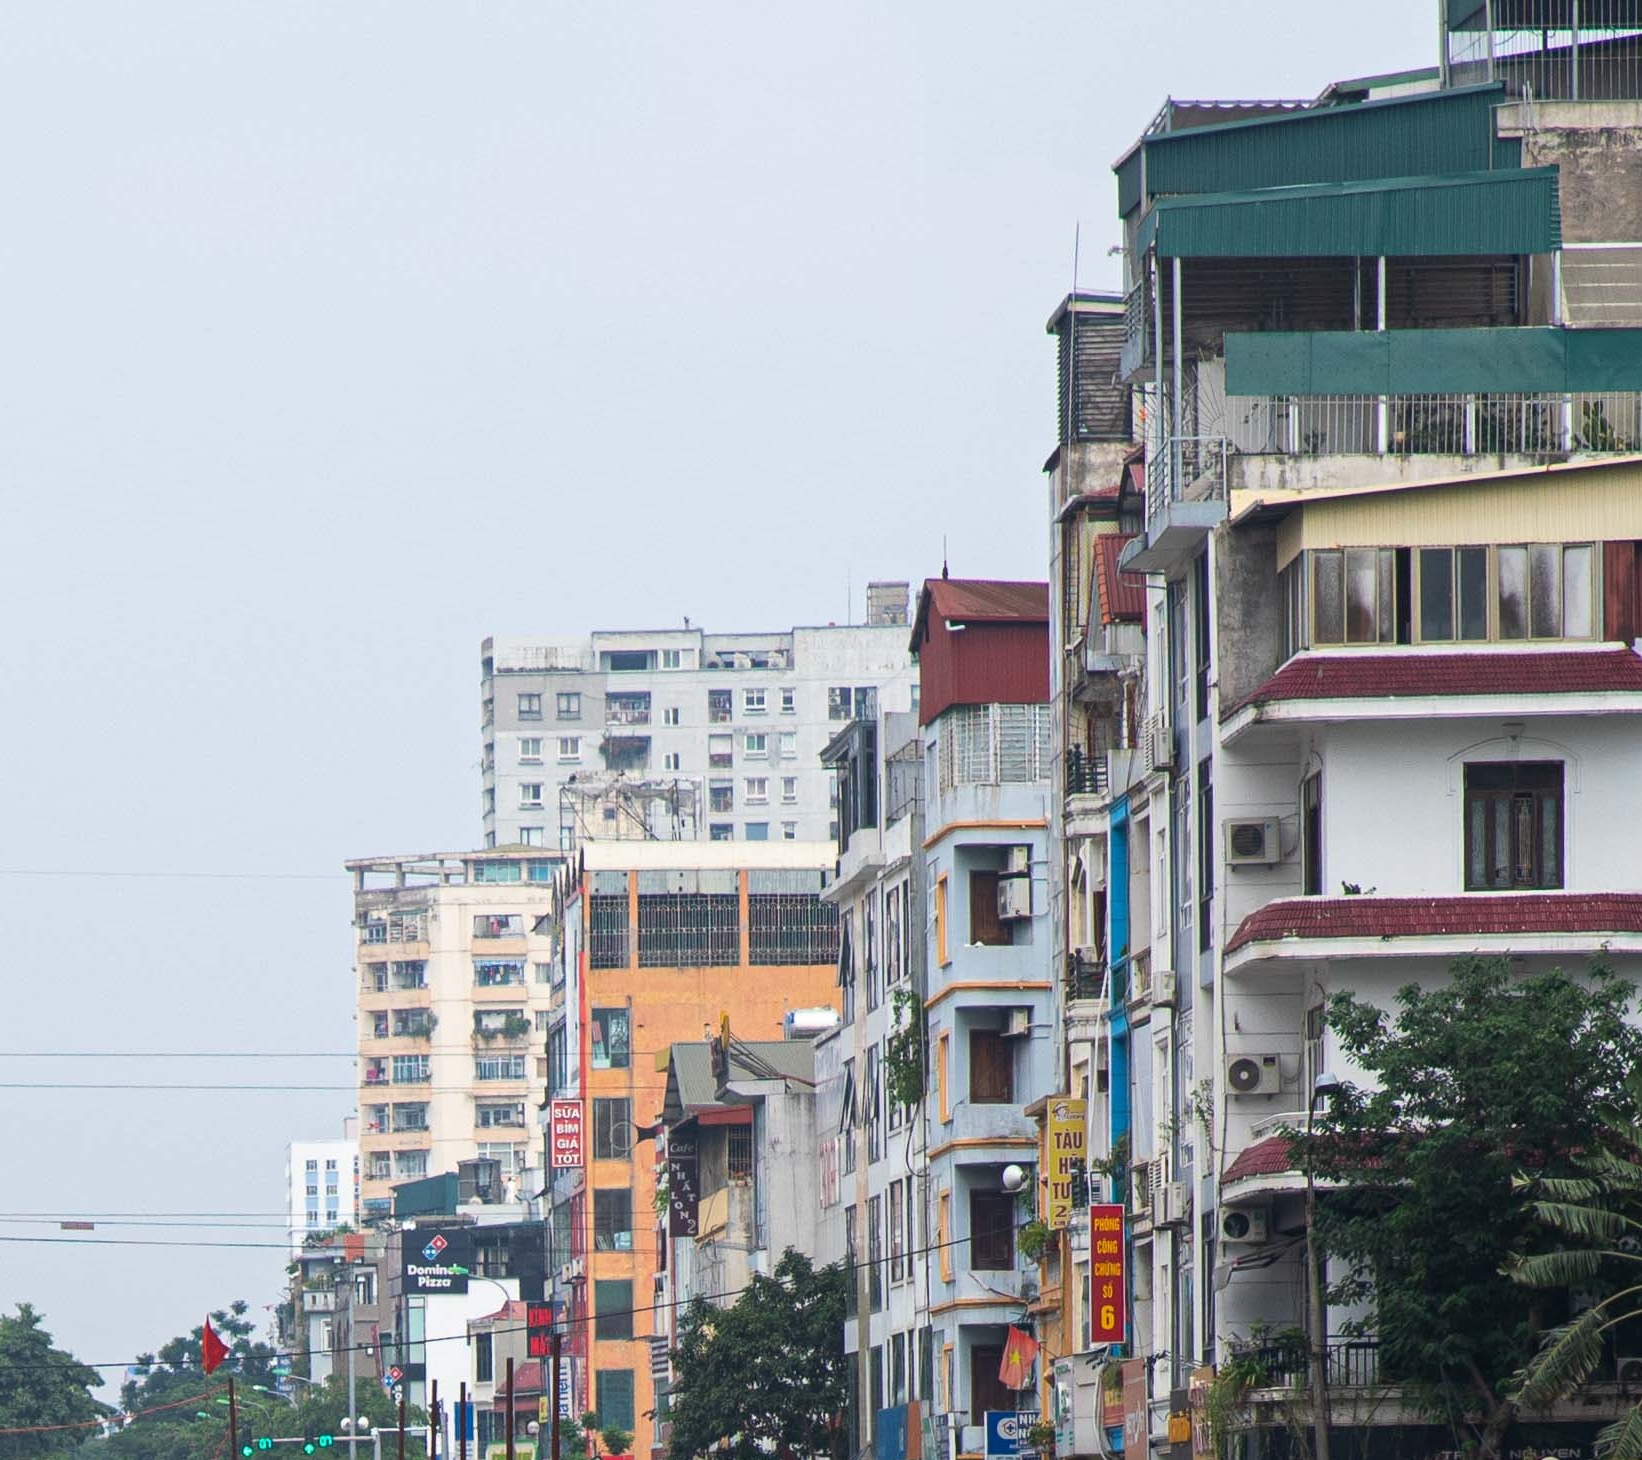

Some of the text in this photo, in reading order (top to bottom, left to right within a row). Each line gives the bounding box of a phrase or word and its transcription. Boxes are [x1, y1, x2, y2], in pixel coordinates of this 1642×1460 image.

[554, 1107, 581, 1119] SỮA
[557, 1136, 579, 1149] GIÁ
[1094, 1214, 1120, 1232] PHÒNG
[1097, 1238, 1118, 1254] CÔNG
[407, 1263, 464, 1276] Domin
[418, 1276, 453, 1288] Pizza
[1102, 1281, 1114, 1298] SỐ
[1100, 1305, 1115, 1331] 6
